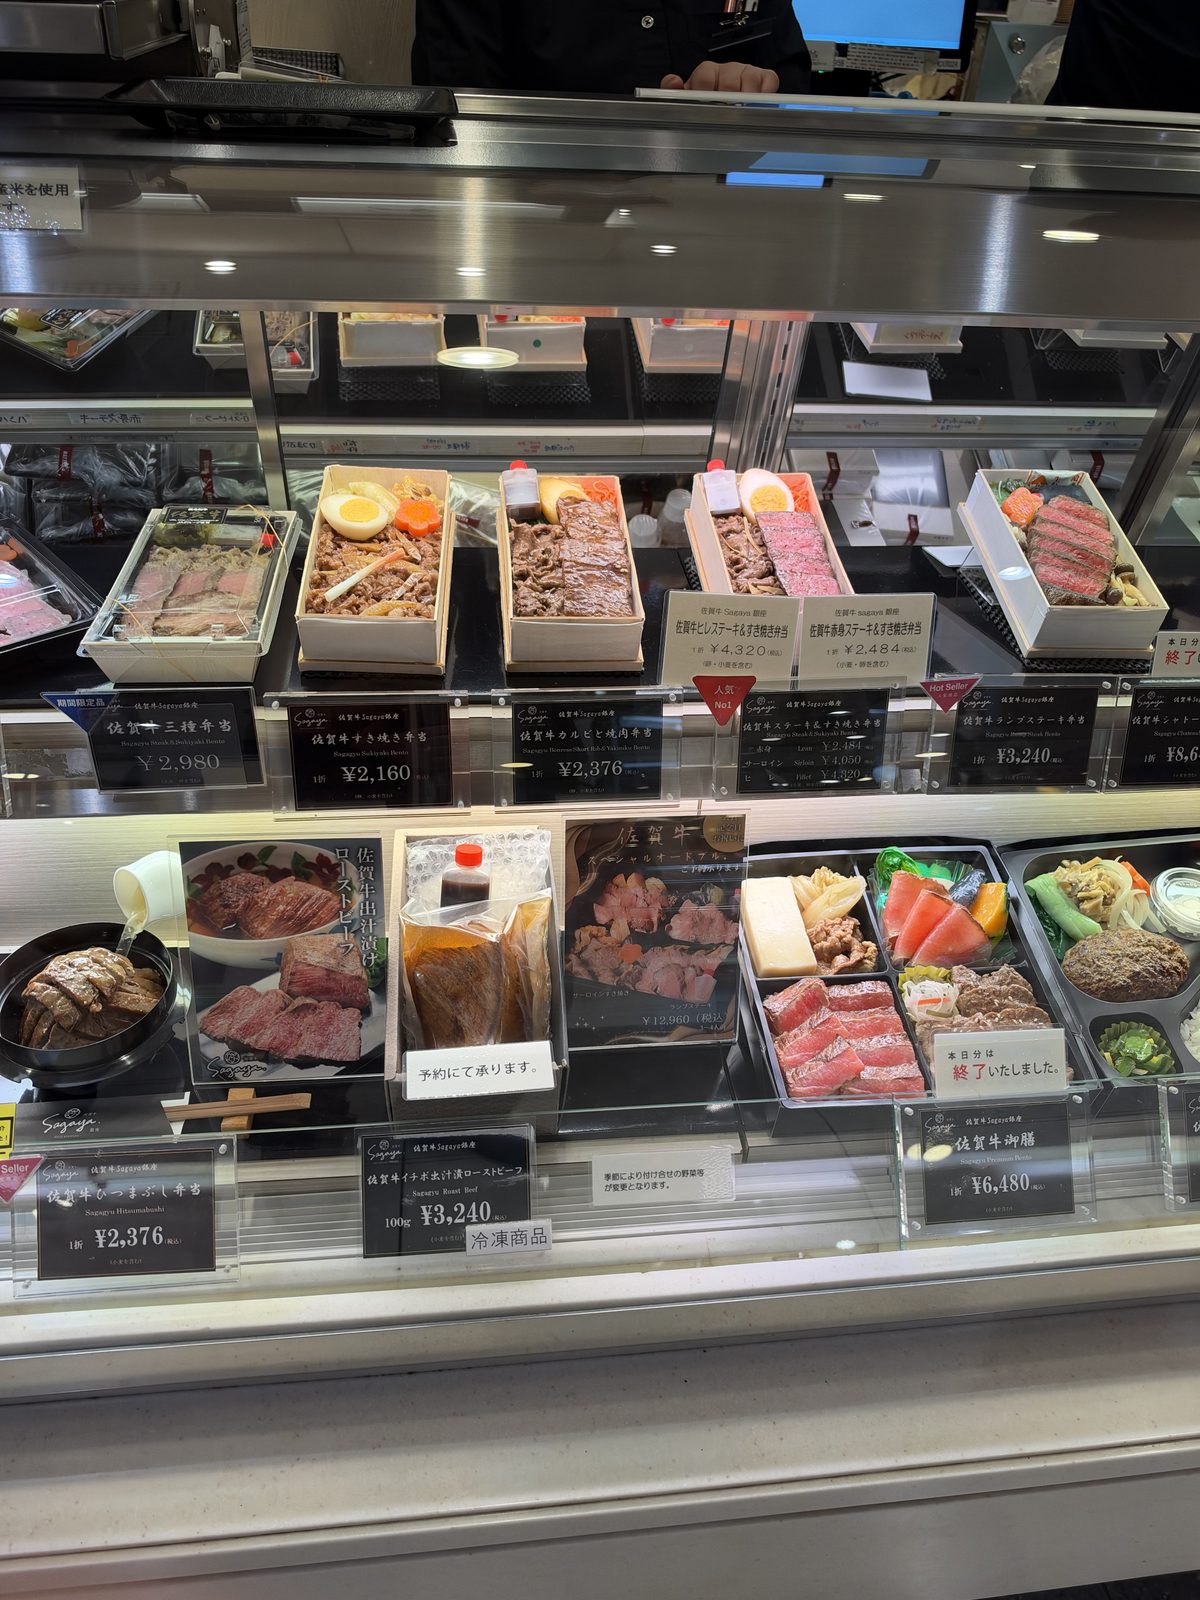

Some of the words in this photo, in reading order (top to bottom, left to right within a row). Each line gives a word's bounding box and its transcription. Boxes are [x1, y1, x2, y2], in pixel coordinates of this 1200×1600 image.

[702, 608, 722, 618] 佐賀牛
[723, 608, 751, 619] Sagaya
[753, 608, 768, 618] 銀座
[835, 609, 857, 619] 佐賀牛
[886, 607, 901, 617] 銀座
[711, 643, 765, 655] ¥4,320
[845, 642, 900, 655] ¥2,484
[714, 684, 734, 695] 人気
[930, 683, 944, 693] Hot
[945, 682, 969, 691] Seller
[57, 697, 106, 708] 期間限定品
[714, 701, 732, 710] No1
[786, 700, 842, 708] 佐賀牛Sagaya銀座
[1001, 696, 1054, 704] 佐賀牛Sagaya銀座
[338, 712, 399, 722] 佐賀牛Sagaya銀座
[558, 710, 616, 719] 佐賀牛Sagaya銀座
[963, 714, 1085, 726] 佐賀牛ランプステーキ弁当
[107, 719, 232, 735] 佐賀牛三種弁当
[312, 731, 428, 745] 佐賀牛すき焼き弁当
[520, 727, 653, 742] 佐賀牛カルビと焼肉弁当
[997, 747, 1051, 765] ¥3,240
[1167, 746, 1200, 763] ¥8,6
[136, 753, 221, 773] ¥2,980
[744, 759, 783, 768] サーロイン
[822, 755, 861, 766] ¥4,050
[341, 765, 411, 784] ¥2,160
[558, 760, 623, 779] ¥2,376
[619, 825, 691, 847] 佐賀牛
[335, 848, 354, 956] ローストビーフ
[357, 847, 378, 968] 佐賀牛出汁漬け
[642, 1015, 690, 1026] ¥12,960
[947, 1049, 995, 1061] 本日分は
[418, 1060, 538, 1083] 予約にて承ります。
[952, 1061, 1060, 1082] 終了いたしました。
[42, 1113, 101, 1134] Sagaya
[965, 1115, 1022, 1126] 佐賀牛Sagaya銀座
[413, 1141, 477, 1153] 佐賀牛Sagaya銀座
[955, 1131, 1036, 1151] 佐賀牛御膳
[1, 1163, 29, 1174] Seller
[90, 1162, 159, 1175] 佐賀牛Sagaya銀座
[604, 1168, 705, 1182] 季節により付け合せの野菜等
[368, 1166, 523, 1186] 佐賀牛イチボ出汁漬ローストビーフ
[604, 1181, 670, 1192] が変更となります。
[949, 1187, 962, 1197] 1折
[971, 1172, 1030, 1195] ¥6,480
[47, 1182, 202, 1204] 佐賀牛ひつまぶし弁当
[412, 1188, 440, 1198] Sagagyu
[442, 1187, 461, 1195] Roast
[464, 1185, 479, 1194] Beef
[84, 1209, 115, 1218] Sagagyu
[385, 1216, 411, 1229] 100g
[420, 1200, 492, 1226] ¥3,240
[69, 1240, 83, 1251] 1折
[94, 1226, 164, 1249] ¥2,376
[471, 1226, 548, 1251] 冷凍商品
